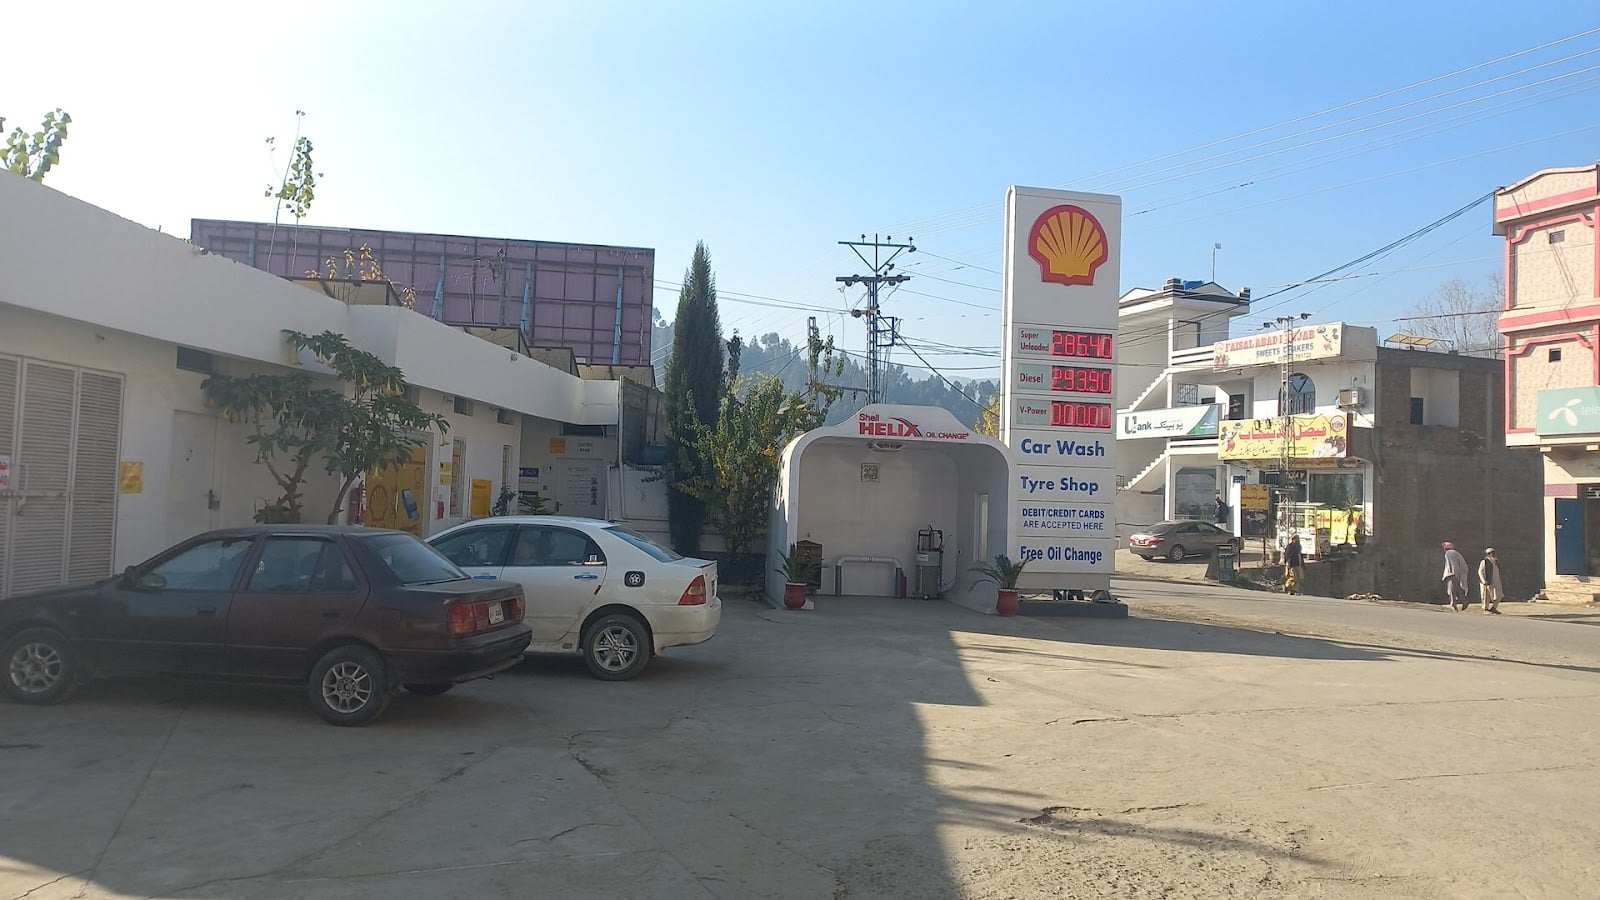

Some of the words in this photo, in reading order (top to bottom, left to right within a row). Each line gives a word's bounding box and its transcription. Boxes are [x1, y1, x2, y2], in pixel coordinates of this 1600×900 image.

[1020, 330, 1039, 340] Super
[1020, 343, 1050, 352] Unleaded
[1225, 341, 1255, 353] FAISAL
[1255, 335, 1279, 348] ABAD
[1256, 347, 1280, 359] SWEETS
[1019, 373, 1044, 383] Diesel
[1019, 405, 1048, 415] V-Power
[859, 413, 880, 422] Shell
[859, 419, 923, 438] HELIX
[1021, 438, 1051, 454] Car
[1056, 440, 1105, 457] Wash
[1020, 475, 1055, 493] Tyre
[1060, 477, 1099, 495] Shop
[1022, 508, 1076, 518] DEBIT/CREDIT
[1078, 509, 1105, 519] CARDS
[1023, 520, 1039, 528] ARE
[1040, 521, 1082, 530] ACCEPTED
[1083, 522, 1104, 530] HERE
[1020, 546, 1043, 560] Free
[1047, 546, 1062, 561] Oil
[1064, 547, 1102, 565] Change
